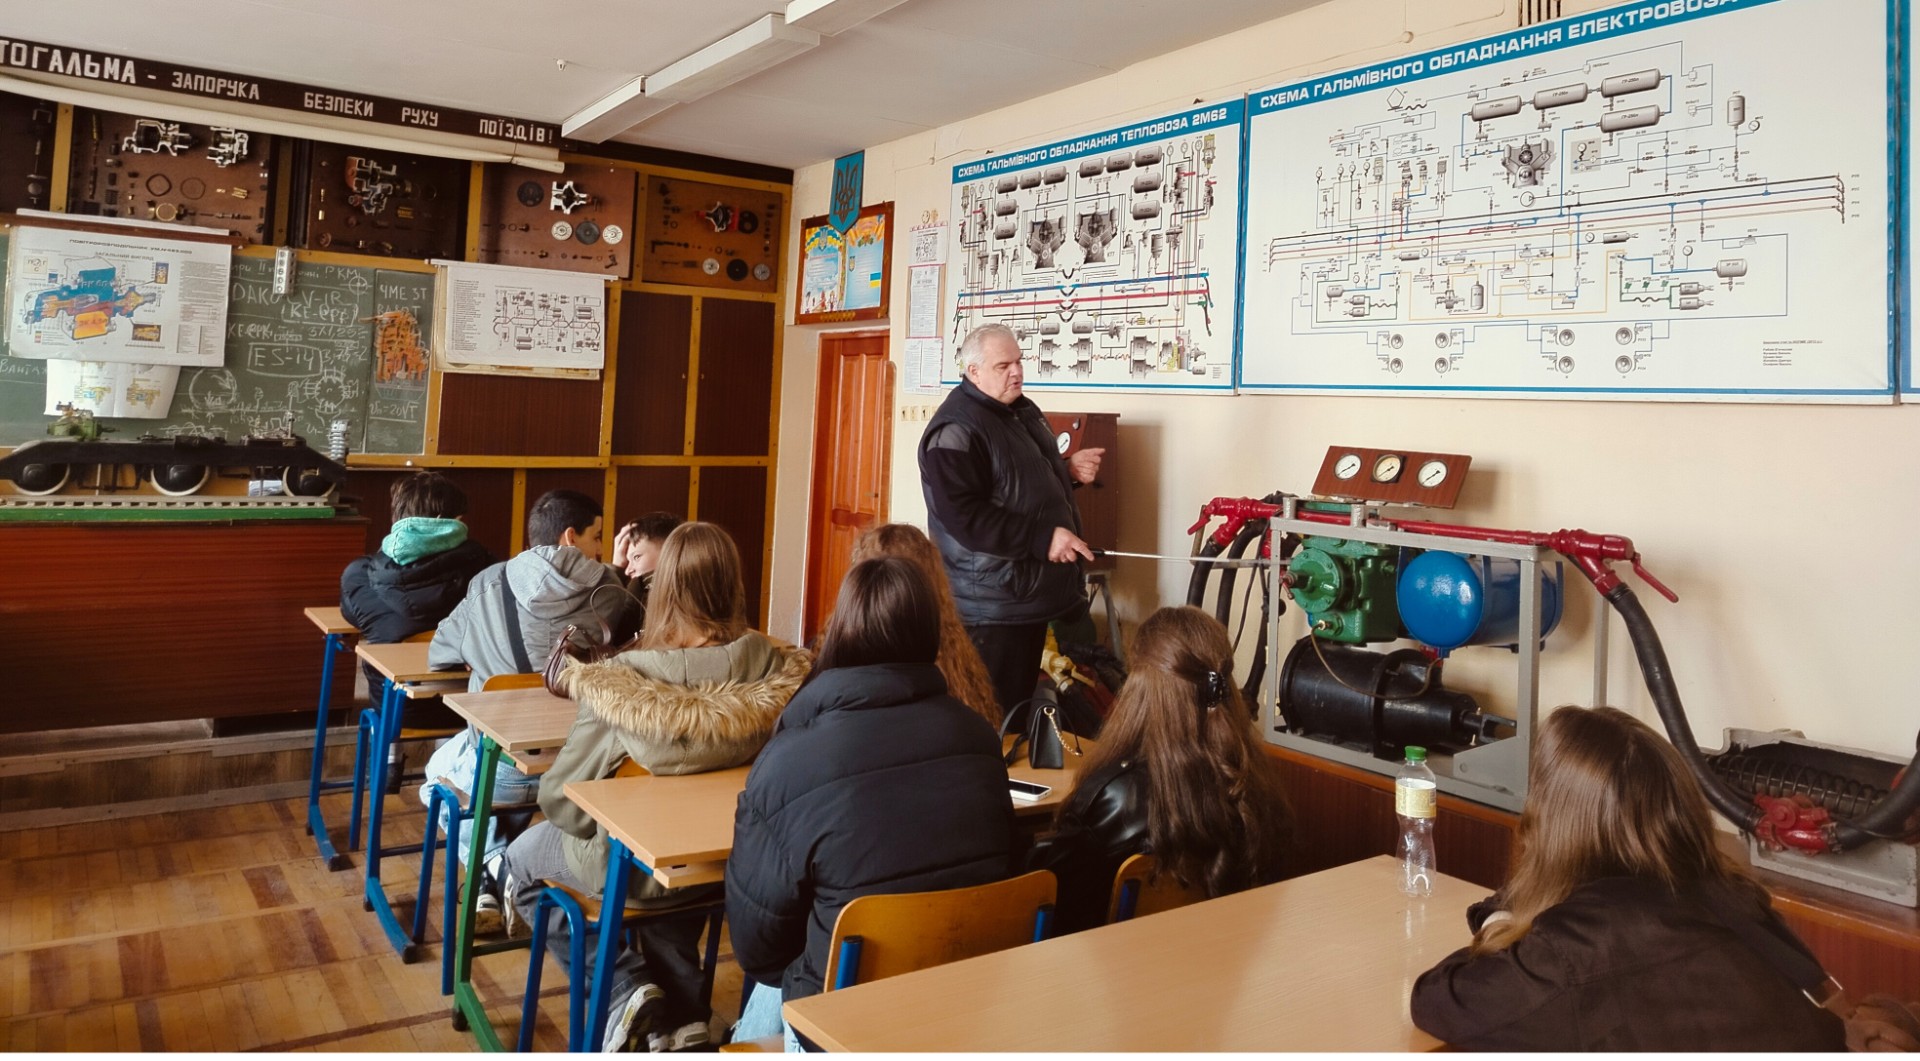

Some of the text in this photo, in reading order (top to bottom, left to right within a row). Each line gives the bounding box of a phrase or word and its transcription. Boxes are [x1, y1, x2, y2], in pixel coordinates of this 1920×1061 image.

[171, 71, 260, 100] ЗАПОРУКА
[303, 91, 374, 117] БЕЗПЕКИ
[401, 106, 439, 128] РУХУ
[1260, 87, 1309, 108] СХЕМА
[1313, 60, 1424, 97] ГАЛЬМІВНОГО
[1429, 27, 1562, 71] ОБЛАДНАННЯ
[957, 107, 1227, 178] СХЕМА ГАЛЬМІВНОГО ОБЛАДНАННЯ ТЕПЛОВОЗА 2М62
